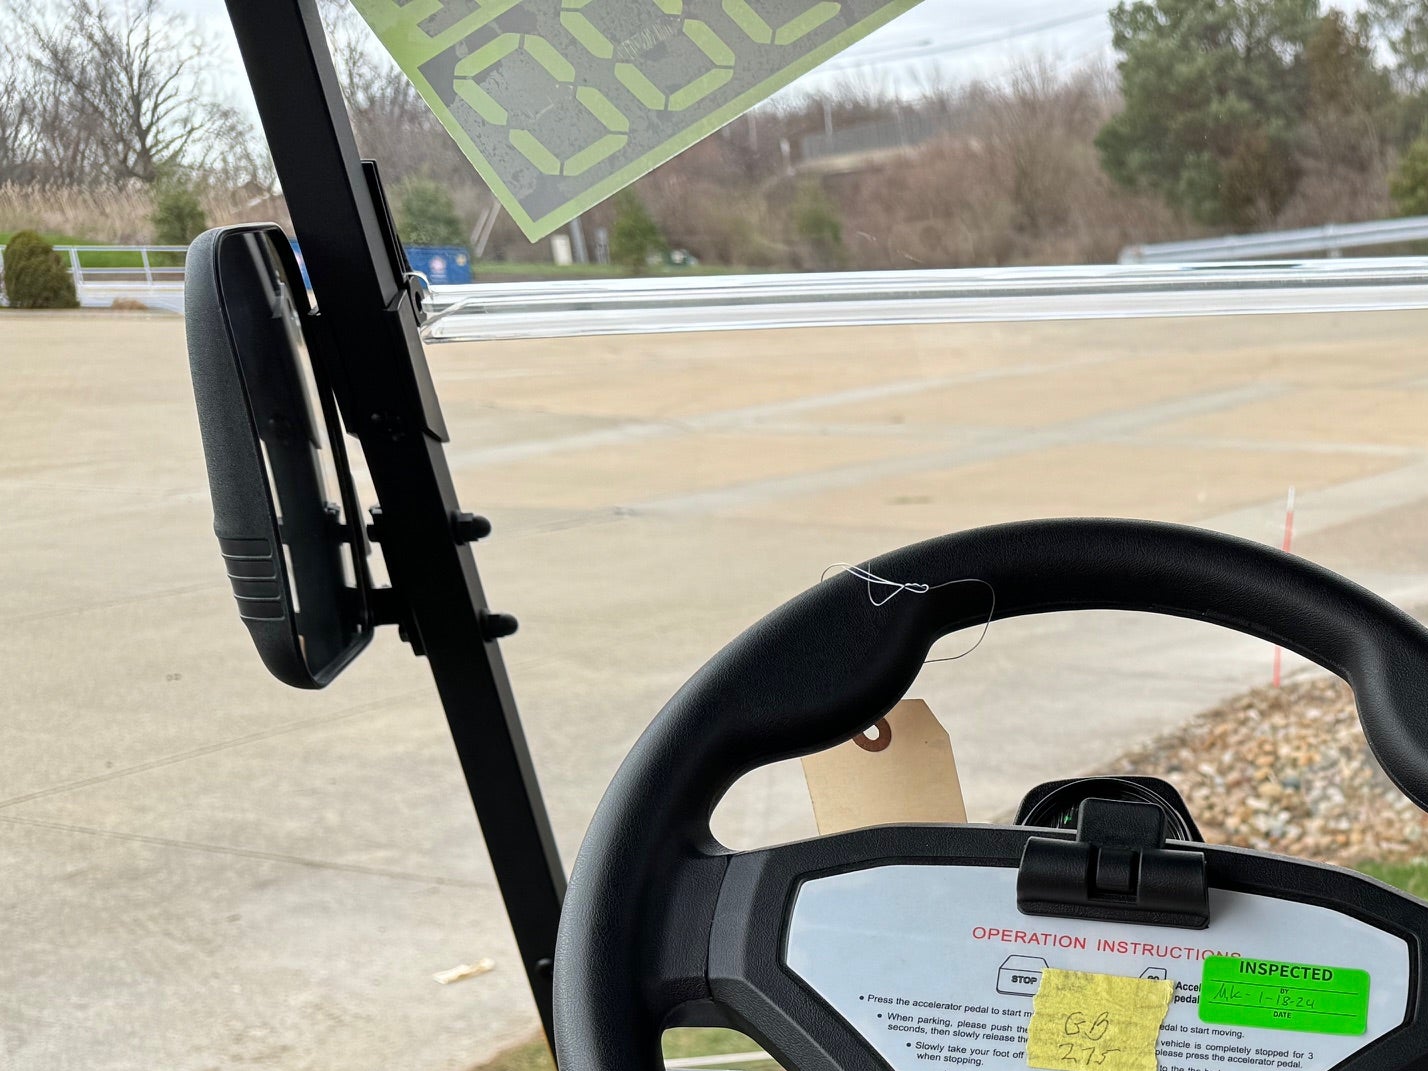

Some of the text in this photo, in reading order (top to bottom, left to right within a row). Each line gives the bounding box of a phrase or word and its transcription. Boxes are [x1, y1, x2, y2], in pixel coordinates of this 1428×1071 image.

[972, 926, 1087, 950] OPERATION
[1011, 974, 1038, 986] STOP
[1239, 960, 1334, 982] INSPECTED
[867, 994, 894, 1005] Press
[896, 997, 911, 1007] the
[912, 1000, 963, 1012] accelerator
[963, 1005, 990, 1015] pedal
[991, 1007, 1001, 1016] to
[1001, 1008, 1023, 1018] start
[1273, 1011, 1292, 1019] DATE
[887, 1012, 914, 1023] When
[917, 1016, 954, 1029] parking,
[956, 1020, 988, 1031] please
[990, 1024, 1014, 1033] push
[1160, 1021, 1245, 1040] edal to start moving.
[887, 1023, 928, 1036] seconds,
[930, 1027, 951, 1037] then
[952, 1029, 981, 1041] slowly
[982, 1032, 1016, 1043] release
[915, 1041, 1025, 1060] Slowly take your foot off
[1160, 1039, 1315, 1061] vehicle is completely stopped for 3
[916, 1052, 985, 1068] when stopping.
[1185, 1052, 1210, 1061] press
[1211, 1053, 1226, 1063] the
[1227, 1056, 1276, 1067] accelerator
[1276, 1060, 1304, 1070] pedal.
